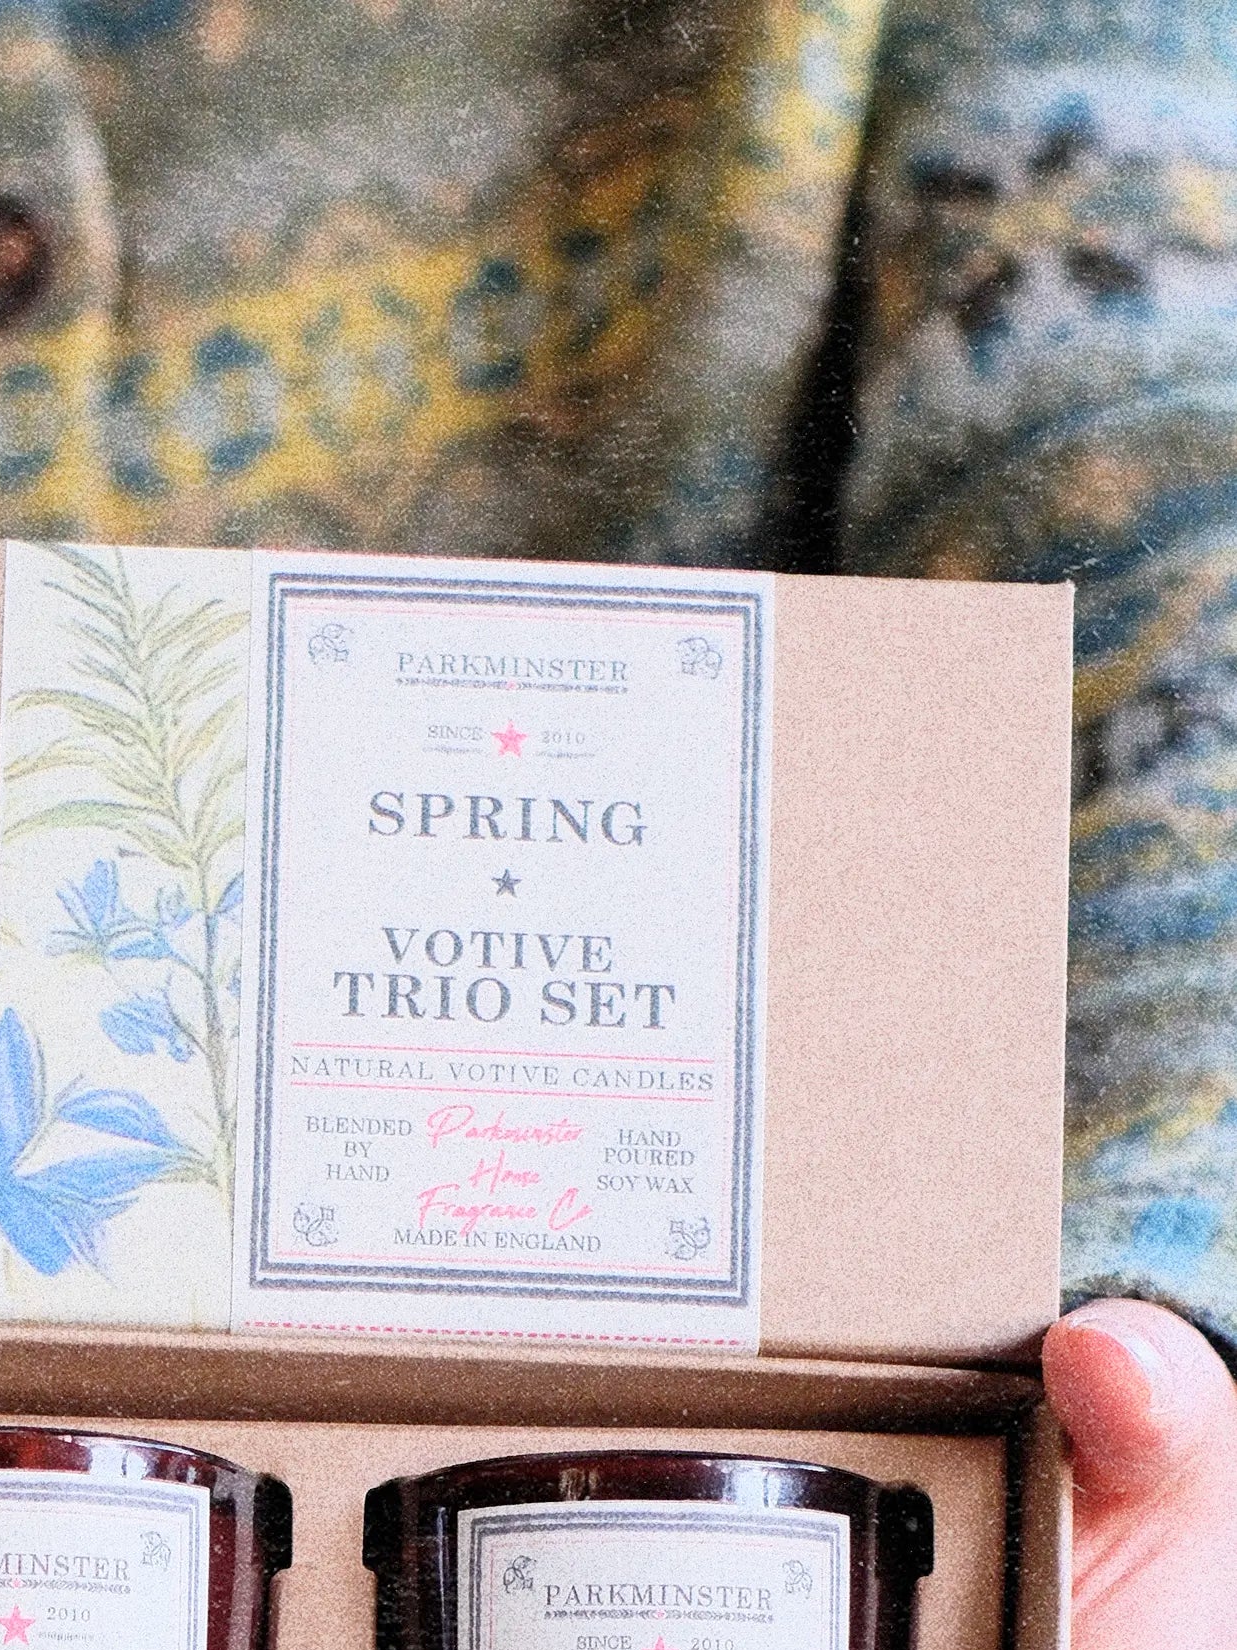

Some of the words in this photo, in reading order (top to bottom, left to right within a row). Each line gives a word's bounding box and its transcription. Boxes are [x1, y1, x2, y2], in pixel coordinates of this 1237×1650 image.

[397, 652, 628, 682] PARKMINSTER
[428, 726, 483, 741] SINCE
[542, 731, 585, 745] 2010
[368, 791, 648, 846] SPRING
[381, 927, 613, 973] VOTIVE
[333, 971, 512, 1022] TRIO
[540, 979, 676, 1030] SET
[291, 1056, 433, 1081] NATURAL
[448, 1063, 559, 1086] VOTIVE
[573, 1068, 714, 1091] CANDLES
[306, 1116, 412, 1136] BLENDED
[619, 1128, 681, 1147] HAND
[345, 1141, 372, 1159] BY
[604, 1149, 695, 1167] POURED
[327, 1164, 390, 1182] HAND
[597, 1174, 640, 1193] SOY
[646, 1176, 695, 1195] WAX
[393, 1230, 456, 1248] MADE
[464, 1232, 487, 1249] IN
[495, 1232, 601, 1253] ENGLAND
[544, 1584, 773, 1611] PARKMINSTER
[47, 1607, 91, 1622] 2010
[577, 1636, 632, 1650] SINCE
